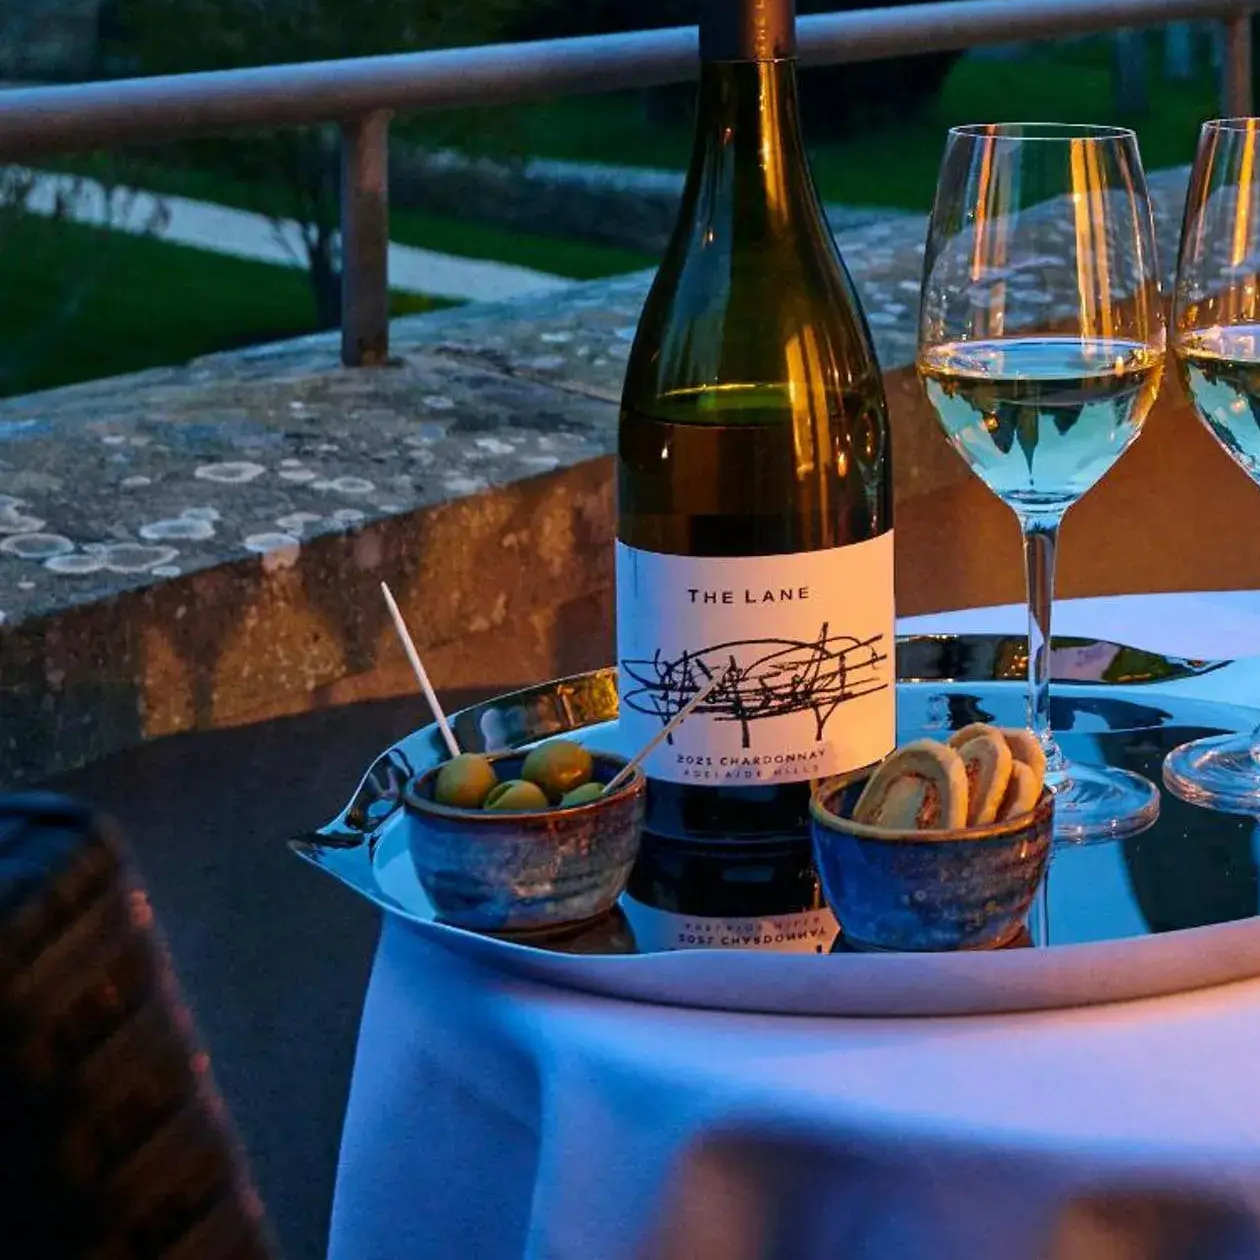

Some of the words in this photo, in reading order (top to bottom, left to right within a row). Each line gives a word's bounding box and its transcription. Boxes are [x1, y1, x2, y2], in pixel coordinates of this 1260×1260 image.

[687, 589, 734, 604] THE
[745, 586, 809, 604] LANE
[676, 753, 714, 766] 2021
[720, 748, 826, 767] CHARDONNAY
